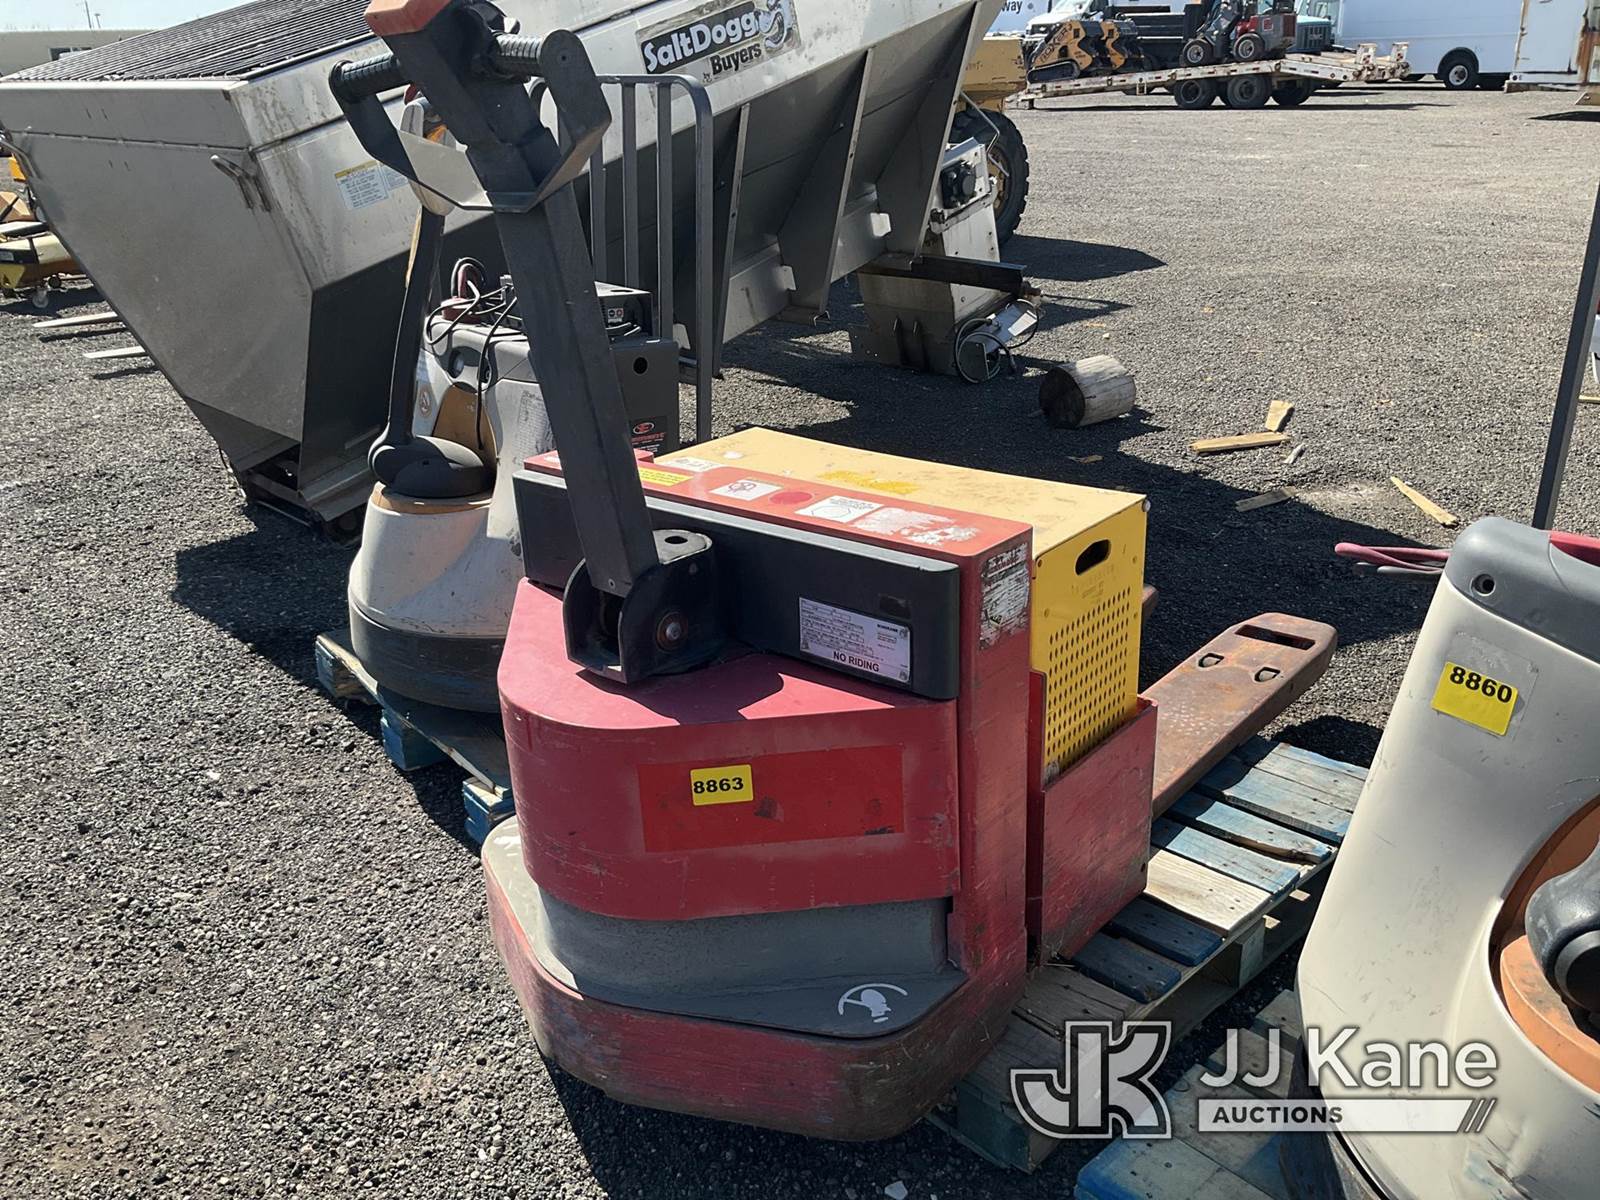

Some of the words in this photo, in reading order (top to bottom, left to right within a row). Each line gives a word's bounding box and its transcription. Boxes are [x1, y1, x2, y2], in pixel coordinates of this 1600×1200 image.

[710, 42, 762, 75] Buyers
[833, 651, 847, 662] NO
[849, 655, 880, 672] RIDING
[1450, 666, 1512, 703] 8860
[693, 777, 744, 794] 8863
